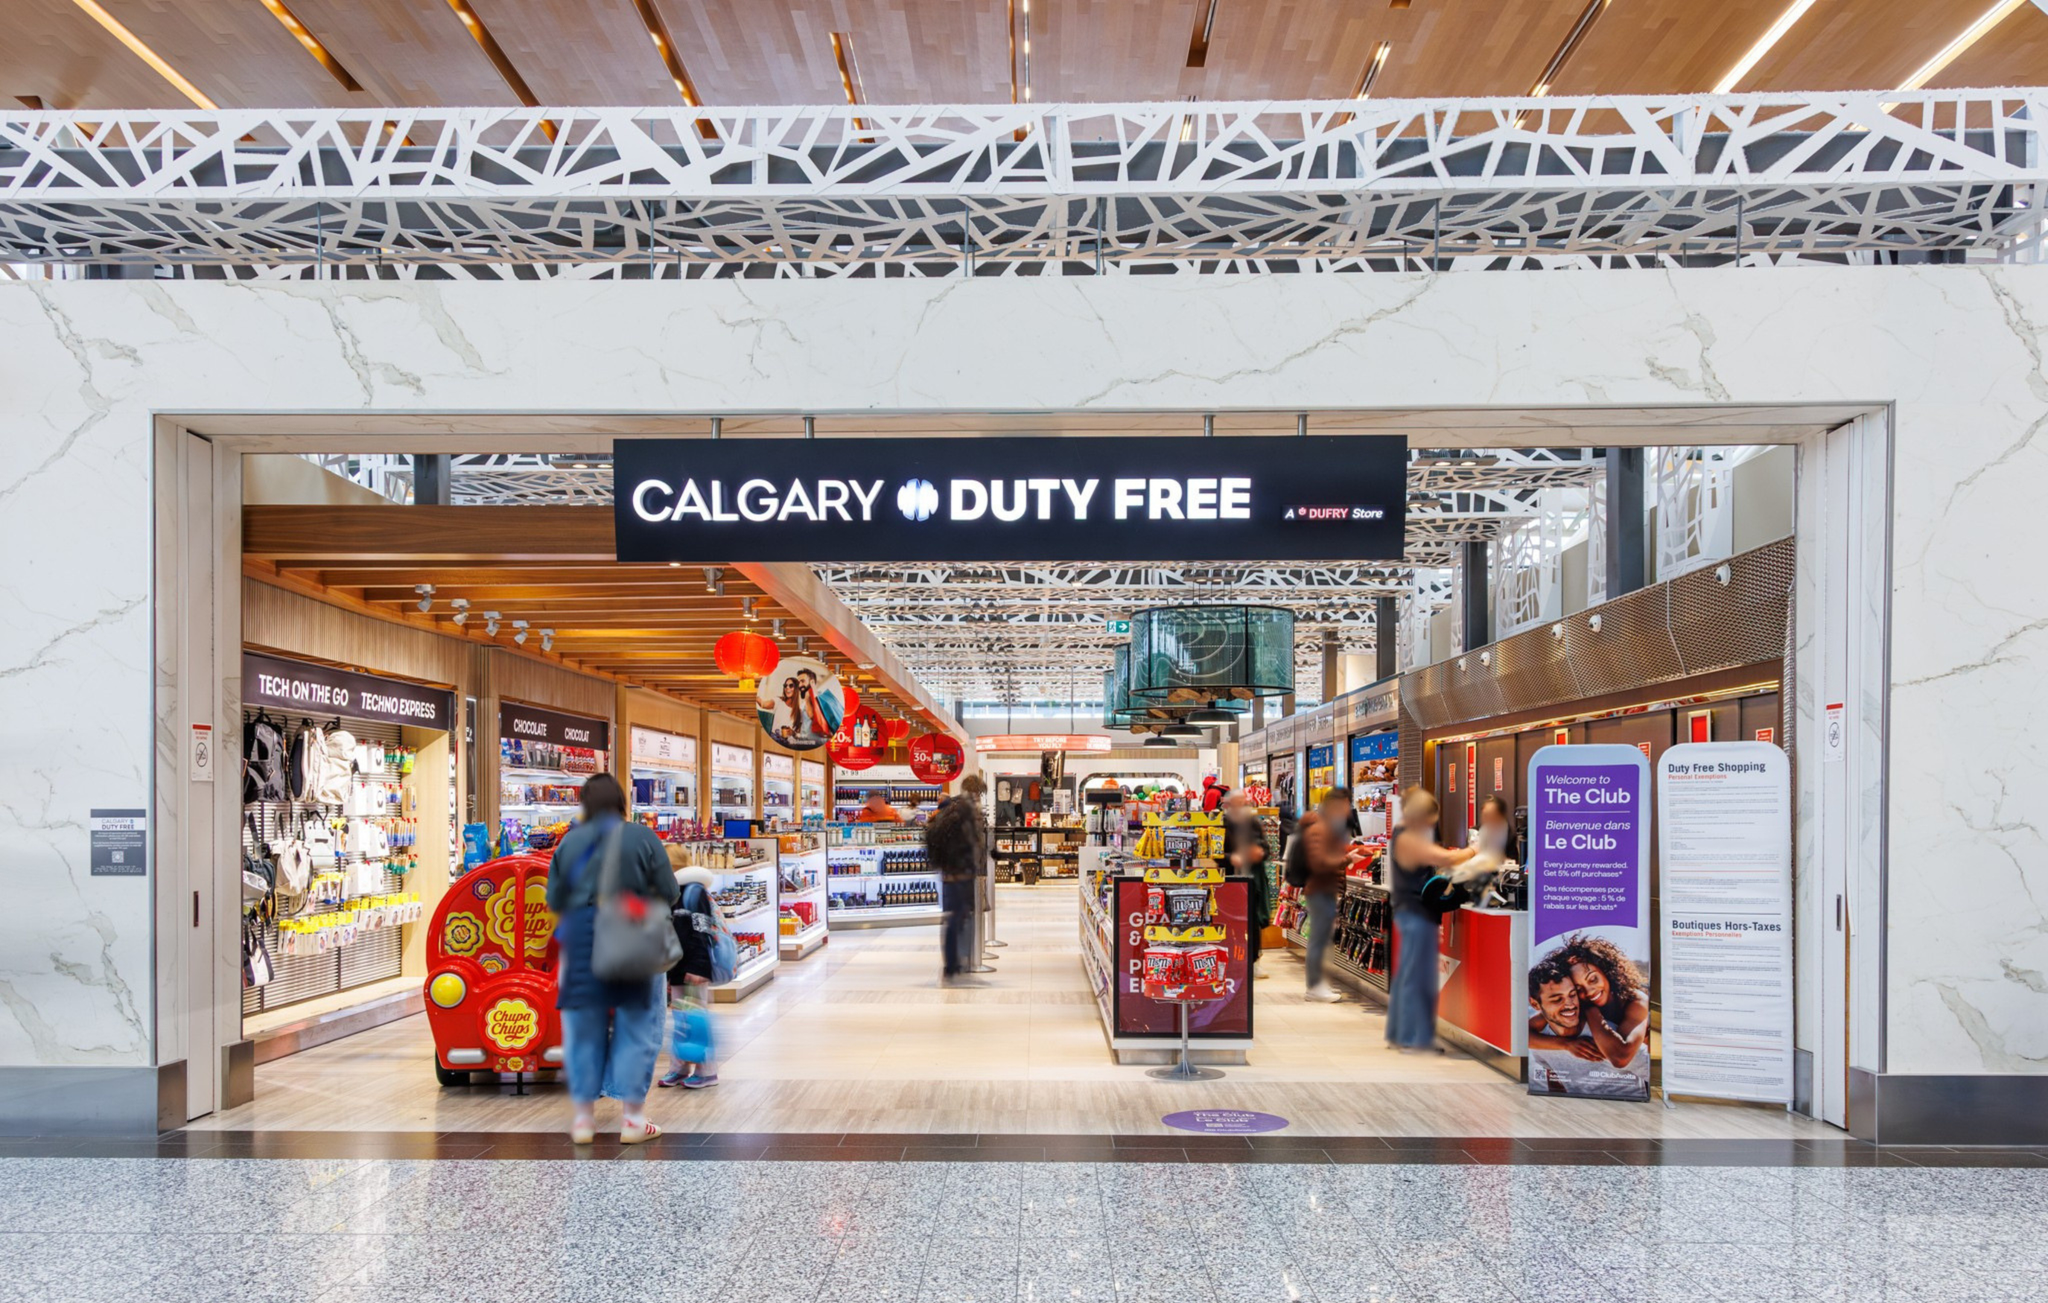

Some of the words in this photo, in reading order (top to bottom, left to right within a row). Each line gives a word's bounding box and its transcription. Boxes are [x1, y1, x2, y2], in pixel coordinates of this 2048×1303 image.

[632, 477, 885, 524] CALGARY
[949, 478, 1100, 521] DUTY
[1114, 477, 1252, 521] FREE
[1284, 508, 1294, 519] A
[1309, 508, 1348, 518] DUFRY
[1352, 508, 1383, 519] Store
[259, 674, 290, 698] TECH
[292, 680, 309, 700] ON
[311, 683, 331, 704] THE
[332, 688, 349, 707] GO
[361, 692, 398, 714] TECHNO
[399, 699, 436, 720] EXPRESS
[513, 718, 547, 736] CHOCOLATE
[564, 727, 590, 742] CHOCOLAT
[914, 752, 932, 762] 30%
[1668, 763, 1690, 774] Duty
[1693, 763, 1714, 772] Free
[1718, 762, 1766, 774] Shopping
[1546, 775, 1596, 785] Welcome
[1599, 775, 1610, 785] to
[1545, 788, 1581, 804] The
[1585, 787, 1631, 804] Club
[1546, 820, 1602, 830] Bienvenue
[1604, 820, 1630, 830] dans
[1544, 834, 1568, 849] Le
[1572, 834, 1617, 850] Club
[1544, 861, 1563, 870] Every
[1564, 861, 1591, 870] journey
[1558, 885, 1606, 893] récompenses
[502, 899, 548, 918] Cup
[1129, 912, 1171, 928] GRA
[1672, 920, 1721, 931] Boutiques
[1725, 921, 1781, 932] Hors-Taxes
[500, 916, 552, 942] Cups
[1129, 930, 1142, 946] &
[493, 1010, 531, 1024] Chupa
[491, 1022, 530, 1042] Chups
[1600, 1071, 1636, 1080] ClubAvolta
